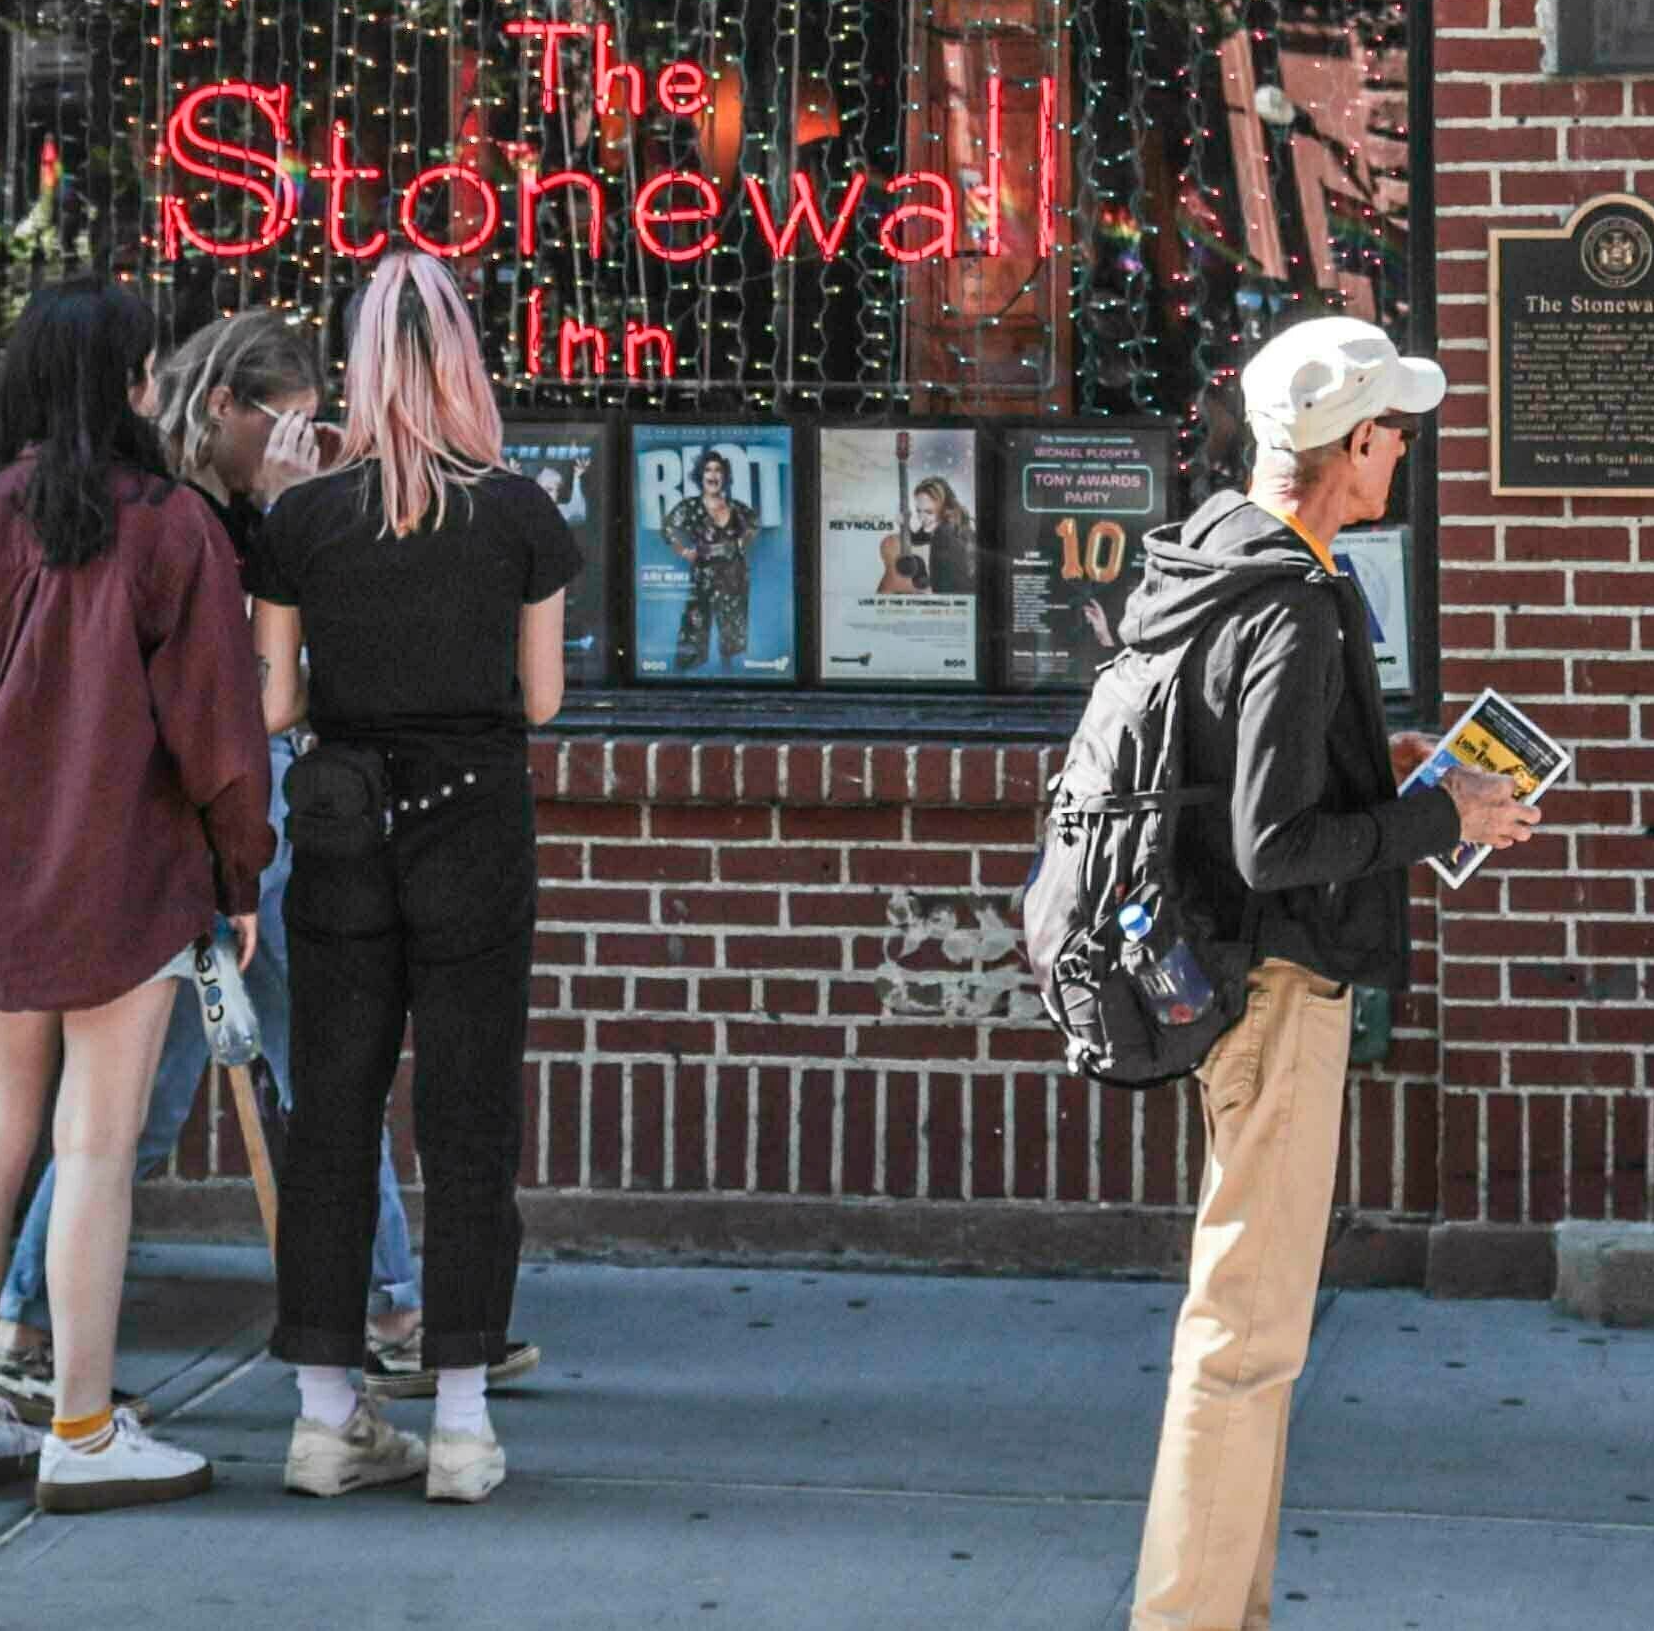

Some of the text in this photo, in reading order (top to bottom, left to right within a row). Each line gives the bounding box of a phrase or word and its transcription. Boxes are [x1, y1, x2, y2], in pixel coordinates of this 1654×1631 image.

[505, 21, 709, 117] The
[161, 76, 1058, 261] Stonewall
[1525, 295, 1563, 313] The
[526, 285, 678, 380] Inn
[1535, 452, 1560, 465] New
[1564, 452, 1592, 465] York
[1034, 474, 1141, 489] TONY AWARDS
[1064, 491, 1111, 505] PARTY
[828, 520, 895, 532] REYNOLDS
[1055, 518, 1126, 583] 10
